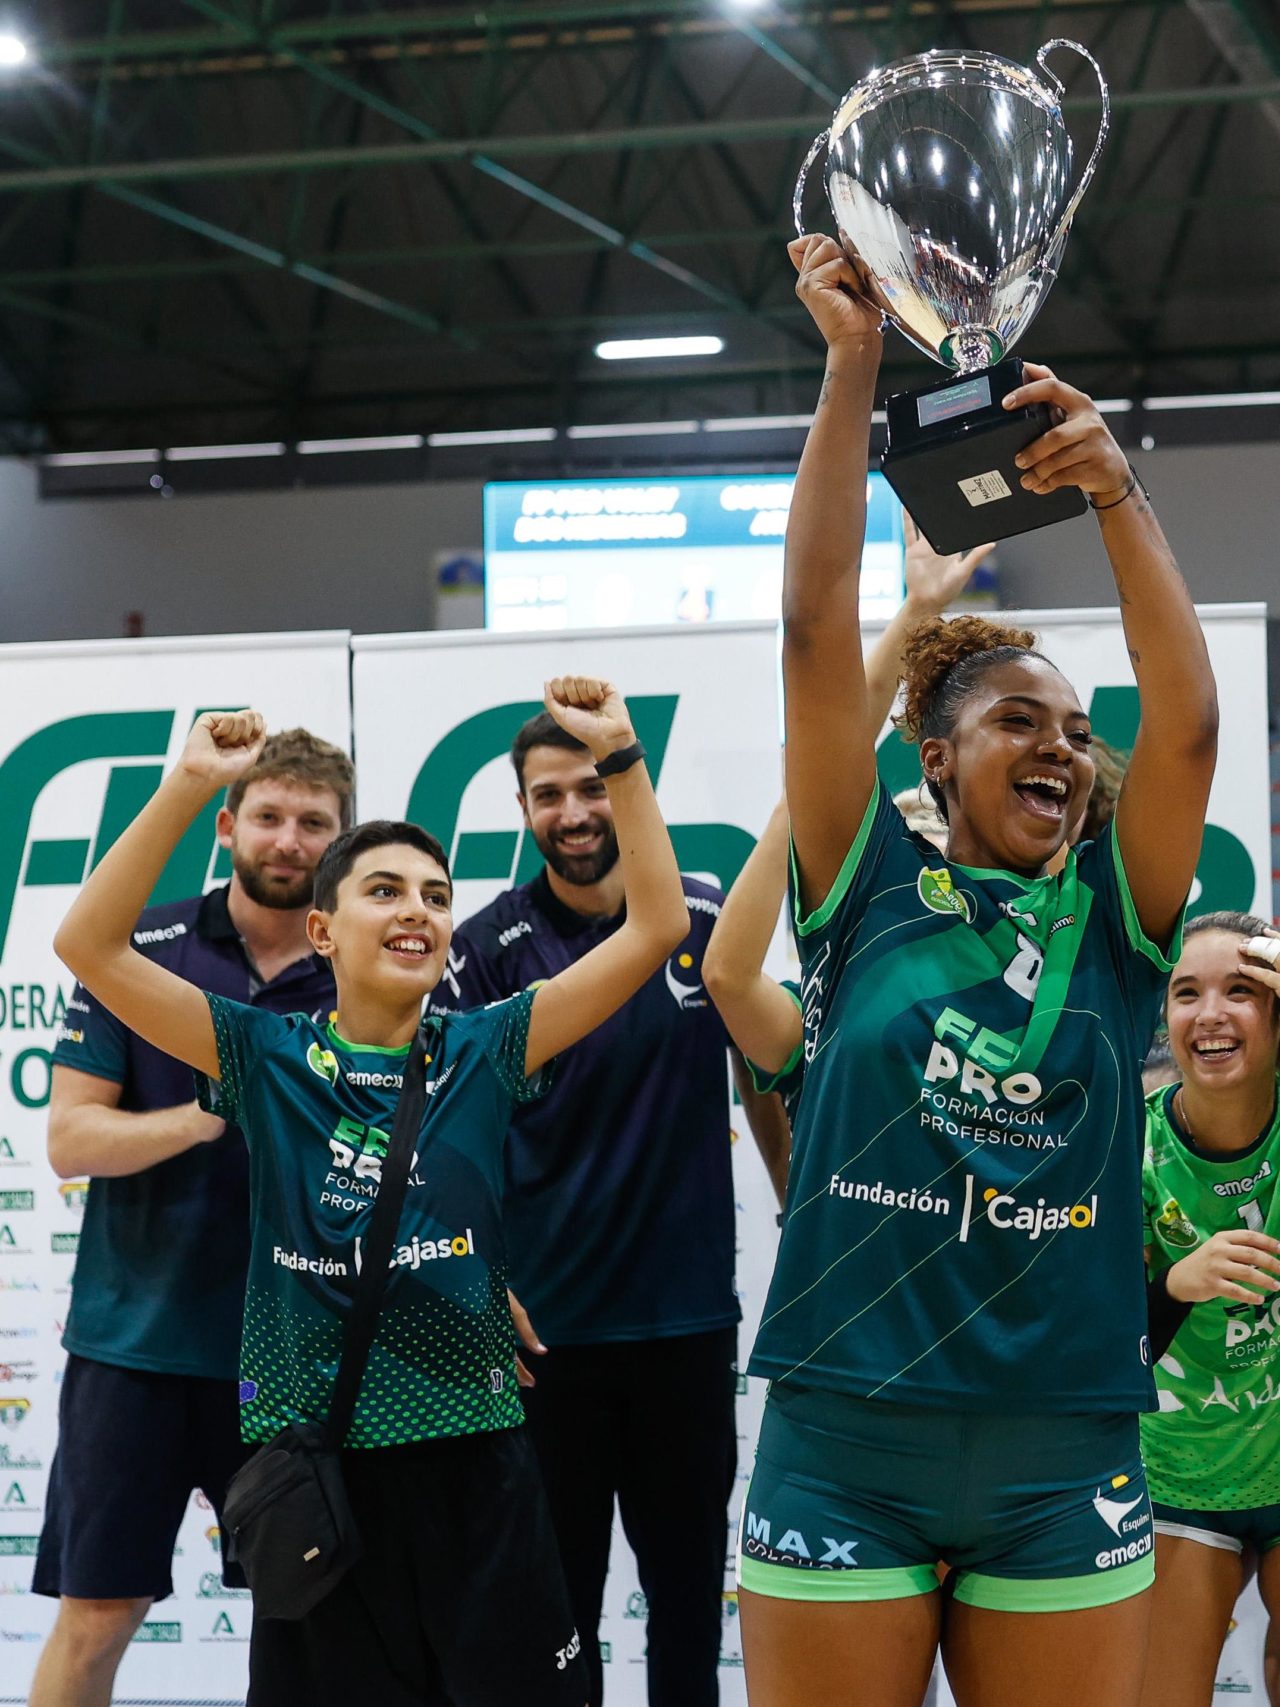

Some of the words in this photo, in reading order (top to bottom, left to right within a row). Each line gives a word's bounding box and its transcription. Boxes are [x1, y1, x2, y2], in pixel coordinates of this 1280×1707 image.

[346, 1072, 394, 1089] emec
[923, 1040, 1043, 1105] PRO
[920, 1087, 1044, 1126] FORMACIÓN
[920, 1112, 1068, 1150] PROFESIONAL
[829, 1174, 950, 1215] Fundación
[984, 1194, 1098, 1241] Cajasol
[388, 1228, 475, 1270] ajasol
[747, 1511, 859, 1566] MAX
[1095, 1537, 1145, 1569] emec
